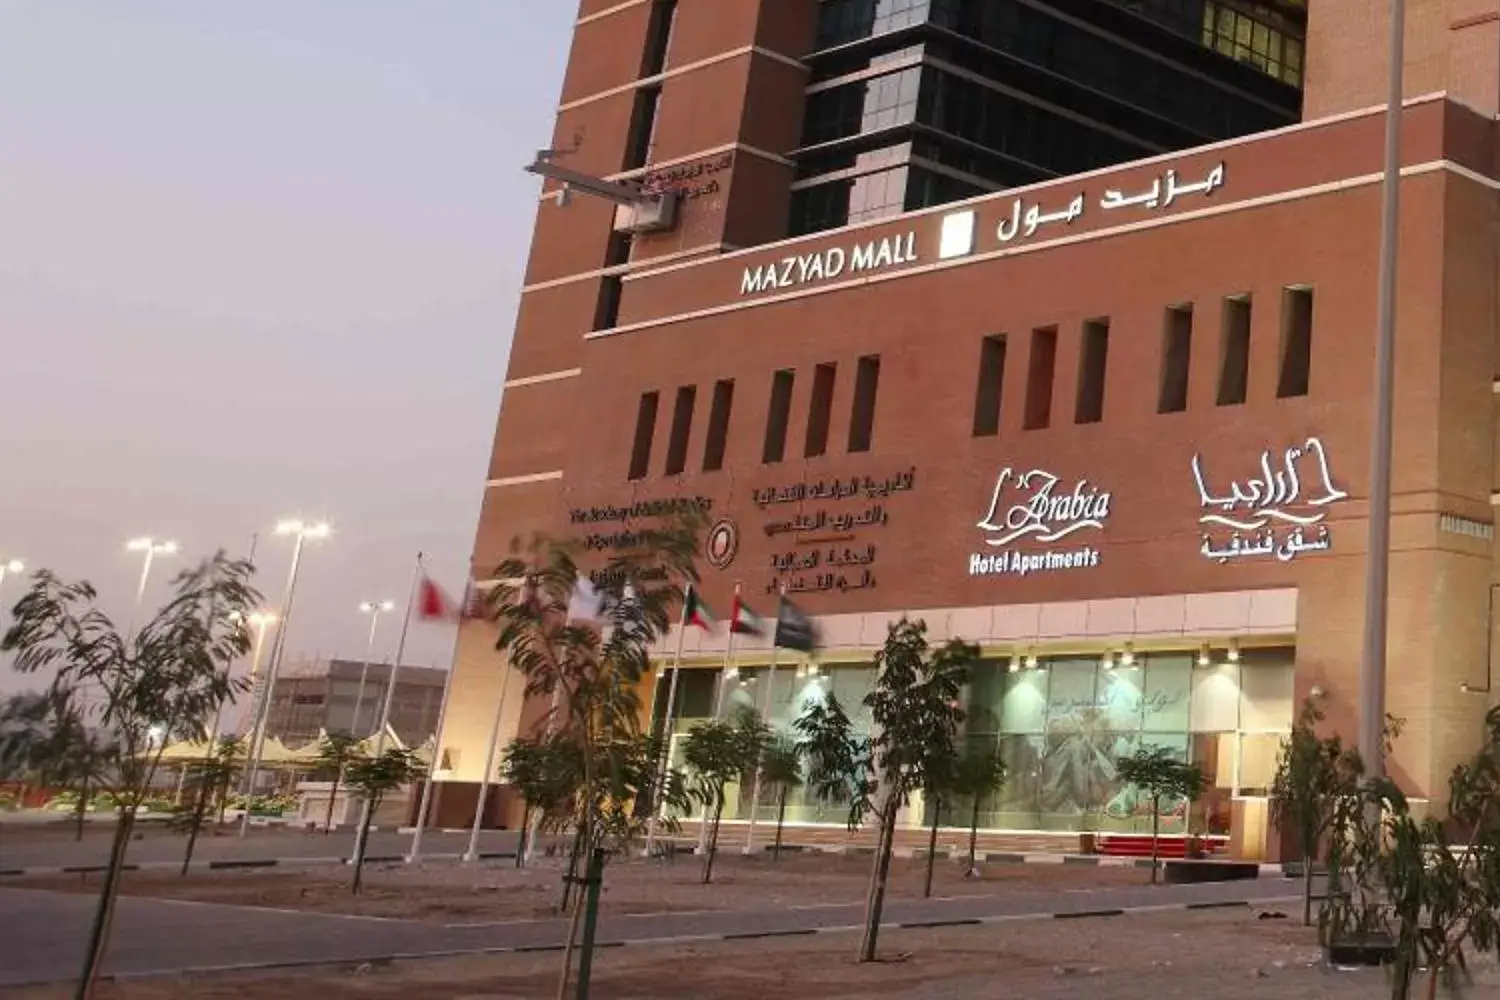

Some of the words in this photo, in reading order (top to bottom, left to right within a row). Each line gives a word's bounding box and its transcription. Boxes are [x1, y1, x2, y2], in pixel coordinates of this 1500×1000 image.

[1100, 162, 1224, 210] مزيد
[997, 191, 1085, 240] مول
[741, 248, 845, 294] MAZYAD
[851, 231, 917, 271] MALL
[969, 551, 1009, 575] Hotel
[1011, 546, 1099, 575] Apartments
[1200, 528, 1274, 564] فندقية
[1277, 525, 1330, 561] شقق
